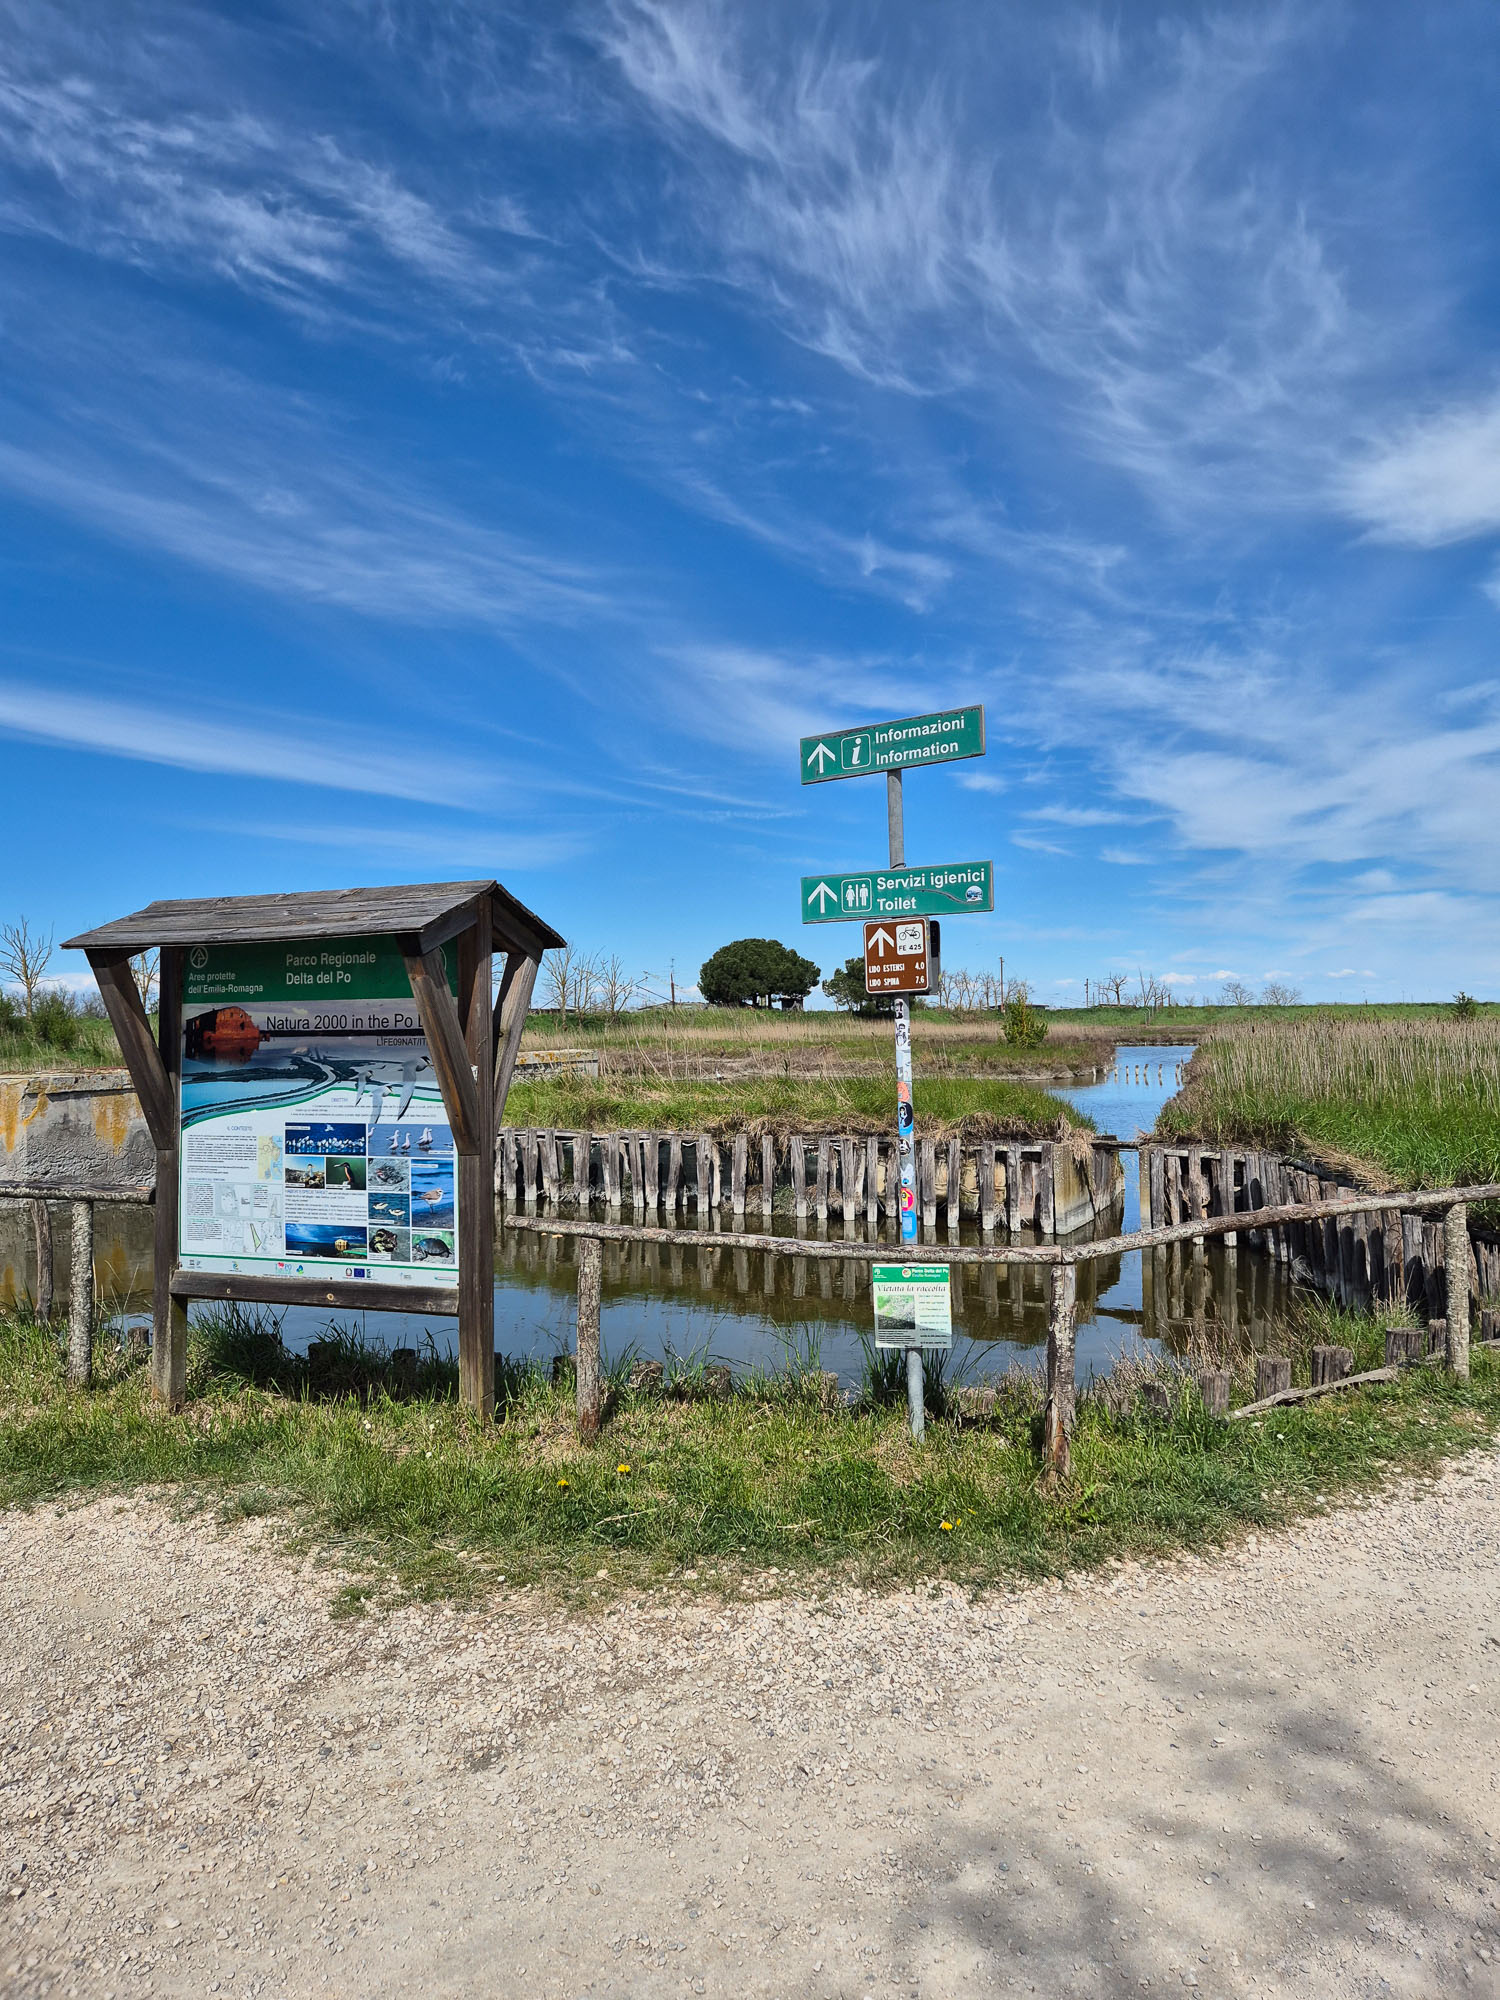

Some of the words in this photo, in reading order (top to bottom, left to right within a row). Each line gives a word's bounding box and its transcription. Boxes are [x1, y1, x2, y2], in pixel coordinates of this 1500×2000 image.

[875, 715, 965, 744] Informazioni
[876, 741, 959, 766] Information
[876, 873, 926, 890] Servizi
[930, 868, 985, 889] igienici
[876, 896, 917, 911] Toilet
[909, 943, 922, 951] 425
[286, 953, 318, 967] Parco
[320, 951, 377, 968] Regionale
[868, 964, 881, 974] LIDO
[883, 963, 905, 972] ESTENSI
[914, 961, 925, 971] 4.0
[188, 972, 206, 982] Aree
[206, 971, 237, 983] protette
[286, 972, 314, 985] Delta
[316, 970, 333, 984] del
[336, 970, 352, 984] Po
[869, 978, 882, 987] LIDO
[883, 976, 900, 986] SPINA
[915, 975, 925, 985] 7.6
[188, 983, 264, 995] dell'Emilia-Romagna
[266, 1014, 311, 1031] Natura
[314, 1014, 348, 1030] 2000
[351, 1013, 364, 1030] in
[368, 1014, 390, 1029] the
[394, 1013, 413, 1028] Po
[376, 1036, 429, 1047] LIFE09NAT/IT
[877, 1284, 905, 1292] Vietata
[906, 1284, 914, 1292] la
[916, 1284, 946, 1293] raccolta
